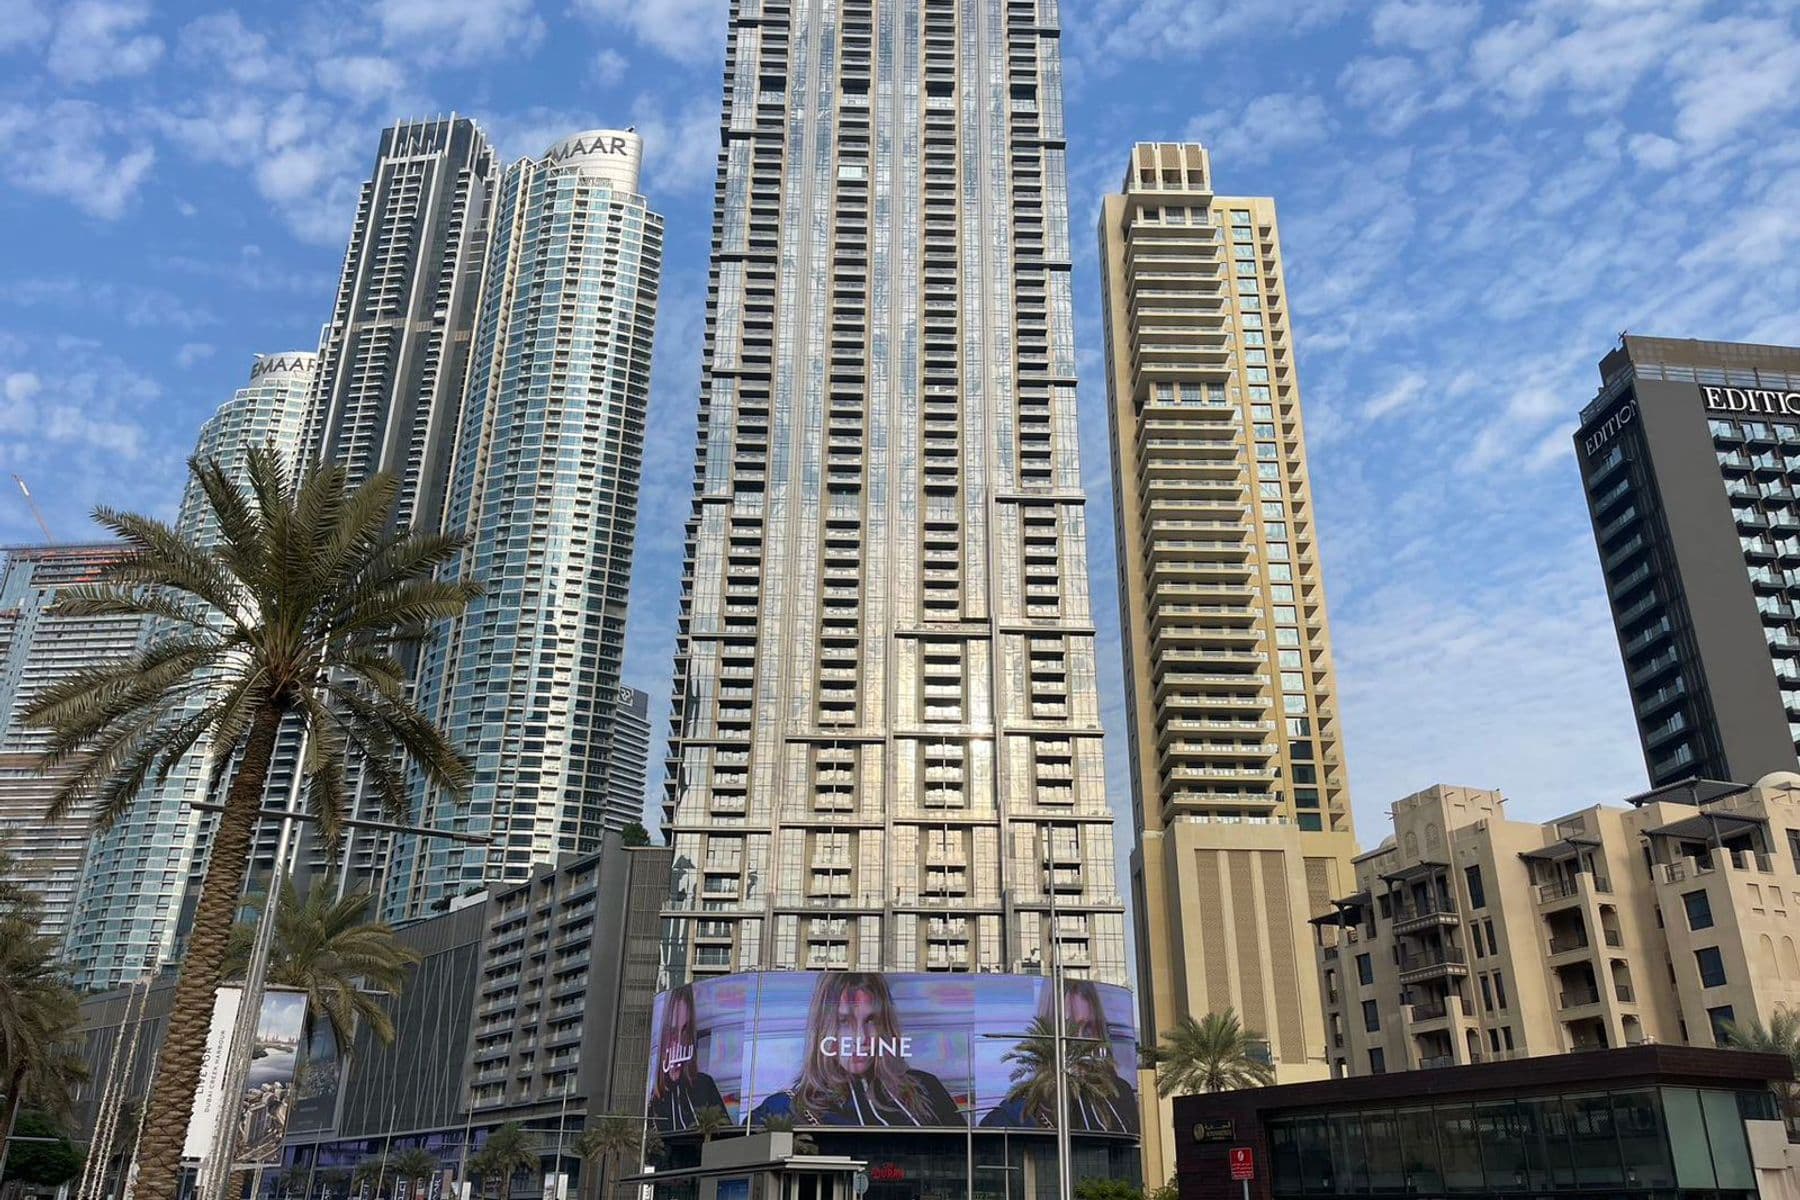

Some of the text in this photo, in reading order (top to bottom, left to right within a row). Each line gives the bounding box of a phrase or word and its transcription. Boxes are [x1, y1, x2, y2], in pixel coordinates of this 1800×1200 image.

[204, 1030, 225, 1112] DUBAI CREEK HARBOUR
[820, 1036, 912, 1057] CELINE
